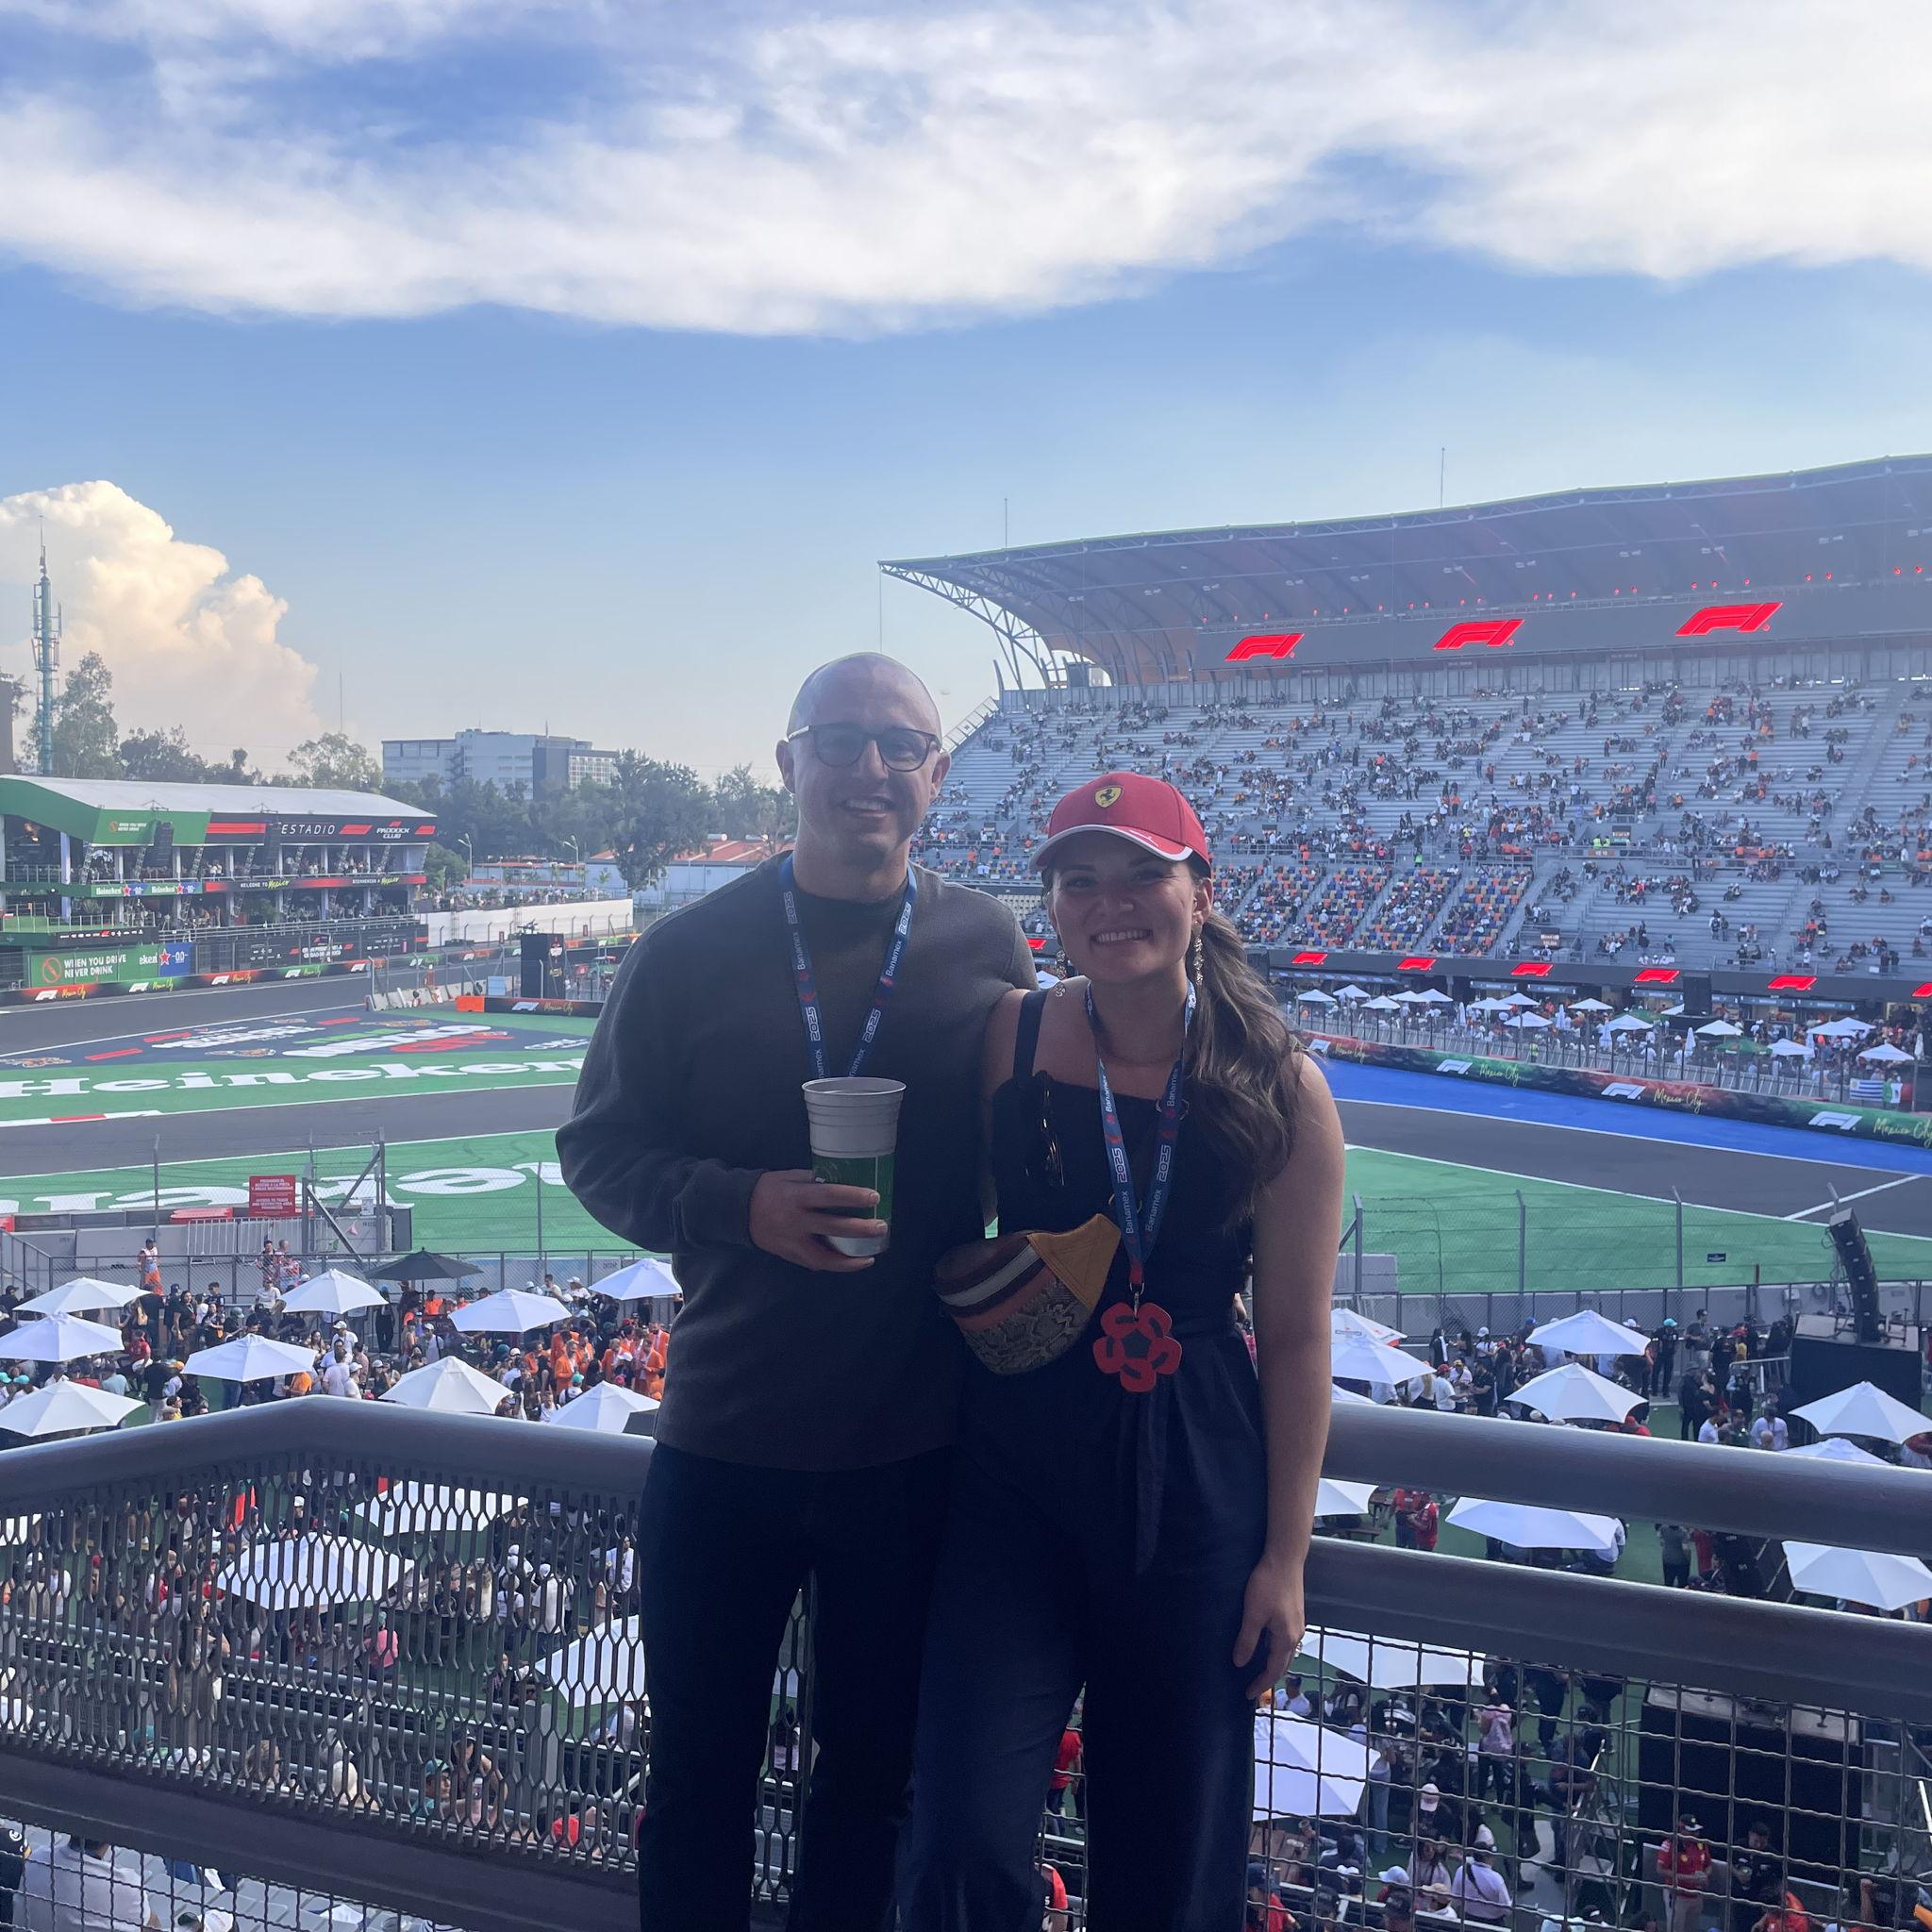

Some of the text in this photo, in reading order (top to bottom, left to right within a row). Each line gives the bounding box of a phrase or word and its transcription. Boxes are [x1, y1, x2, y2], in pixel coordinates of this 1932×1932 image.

[281, 824, 336, 835] ESTADIO
[784, 891, 798, 924] 2025
[898, 901, 912, 935] 2025
[64, 954, 126, 969] WHEN YOU DRIVE
[64, 965, 113, 979] NEVER DRINK
[885, 939, 903, 977] Banamex
[806, 1007, 821, 1041] 2025
[862, 1008, 882, 1043] 2025
[815, 1049, 824, 1079] namex
[850, 1048, 866, 1078] namex
[1480, 1063, 1505, 1079] Mexico
[1654, 1088, 1684, 1104] Mexico
[1686, 1088, 1706, 1114] City
[1874, 1117, 1910, 1137] Mexico
[1112, 1147, 1128, 1183] 2025
[1157, 1144, 1172, 1183] 2025
[1122, 1191, 1134, 1234] Banamex
[1145, 1189, 1162, 1232] Banamex
